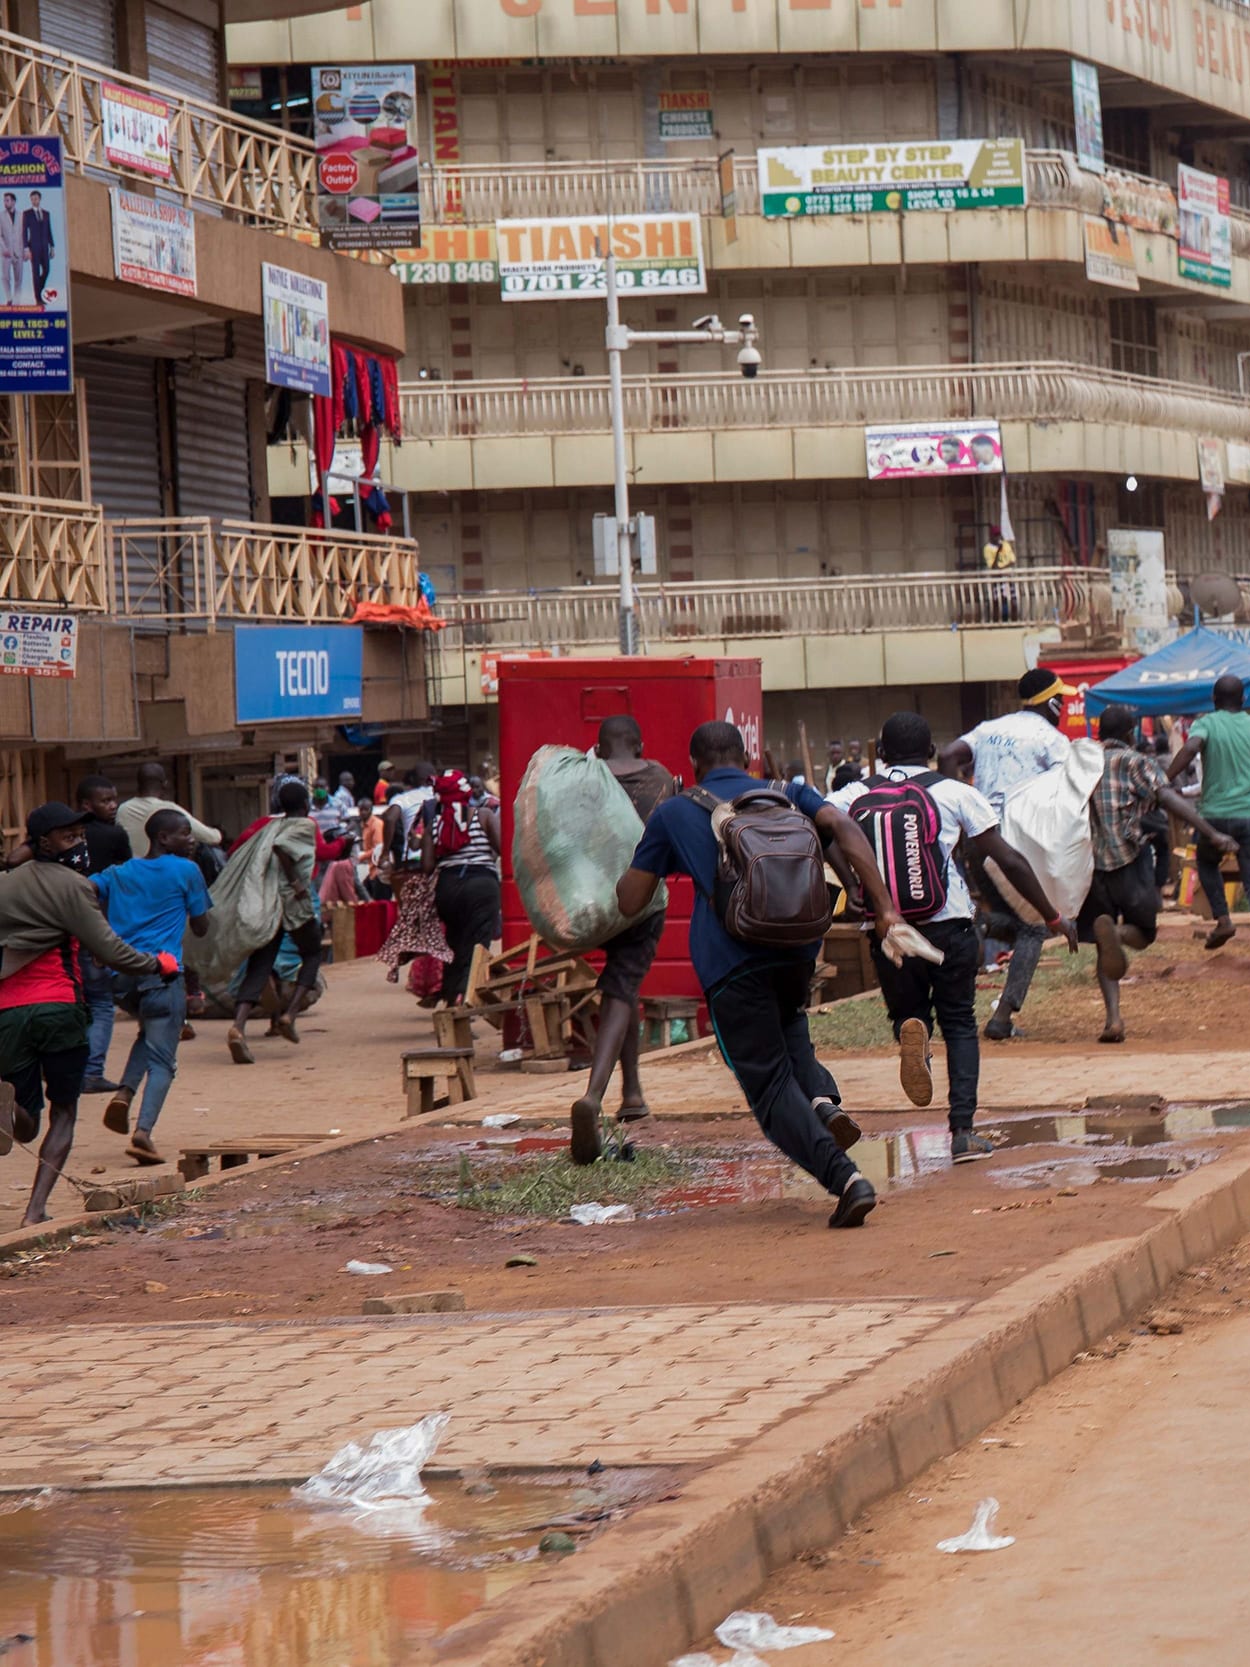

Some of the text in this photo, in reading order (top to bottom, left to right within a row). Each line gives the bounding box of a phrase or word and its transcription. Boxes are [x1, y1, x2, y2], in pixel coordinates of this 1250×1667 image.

[10, 142, 29, 154] IN
[823, 146, 952, 164] STEP BY STEP
[322, 163, 355, 173] Factory
[811, 164, 964, 183] BEAUTY CENTER
[326, 175, 353, 184] Outlet
[907, 200, 939, 209] LEVEL
[500, 220, 693, 263] TIANSHI
[411, 263, 451, 284] 230
[455, 262, 494, 283] 846
[504, 273, 577, 292] 0701
[640, 268, 698, 288] 846
[13, 330, 35, 339] LEVEL
[8, 615, 73, 634] REPAIR
[276, 650, 328, 696] TECNO
[903, 813, 925, 900] POWERWORLD
